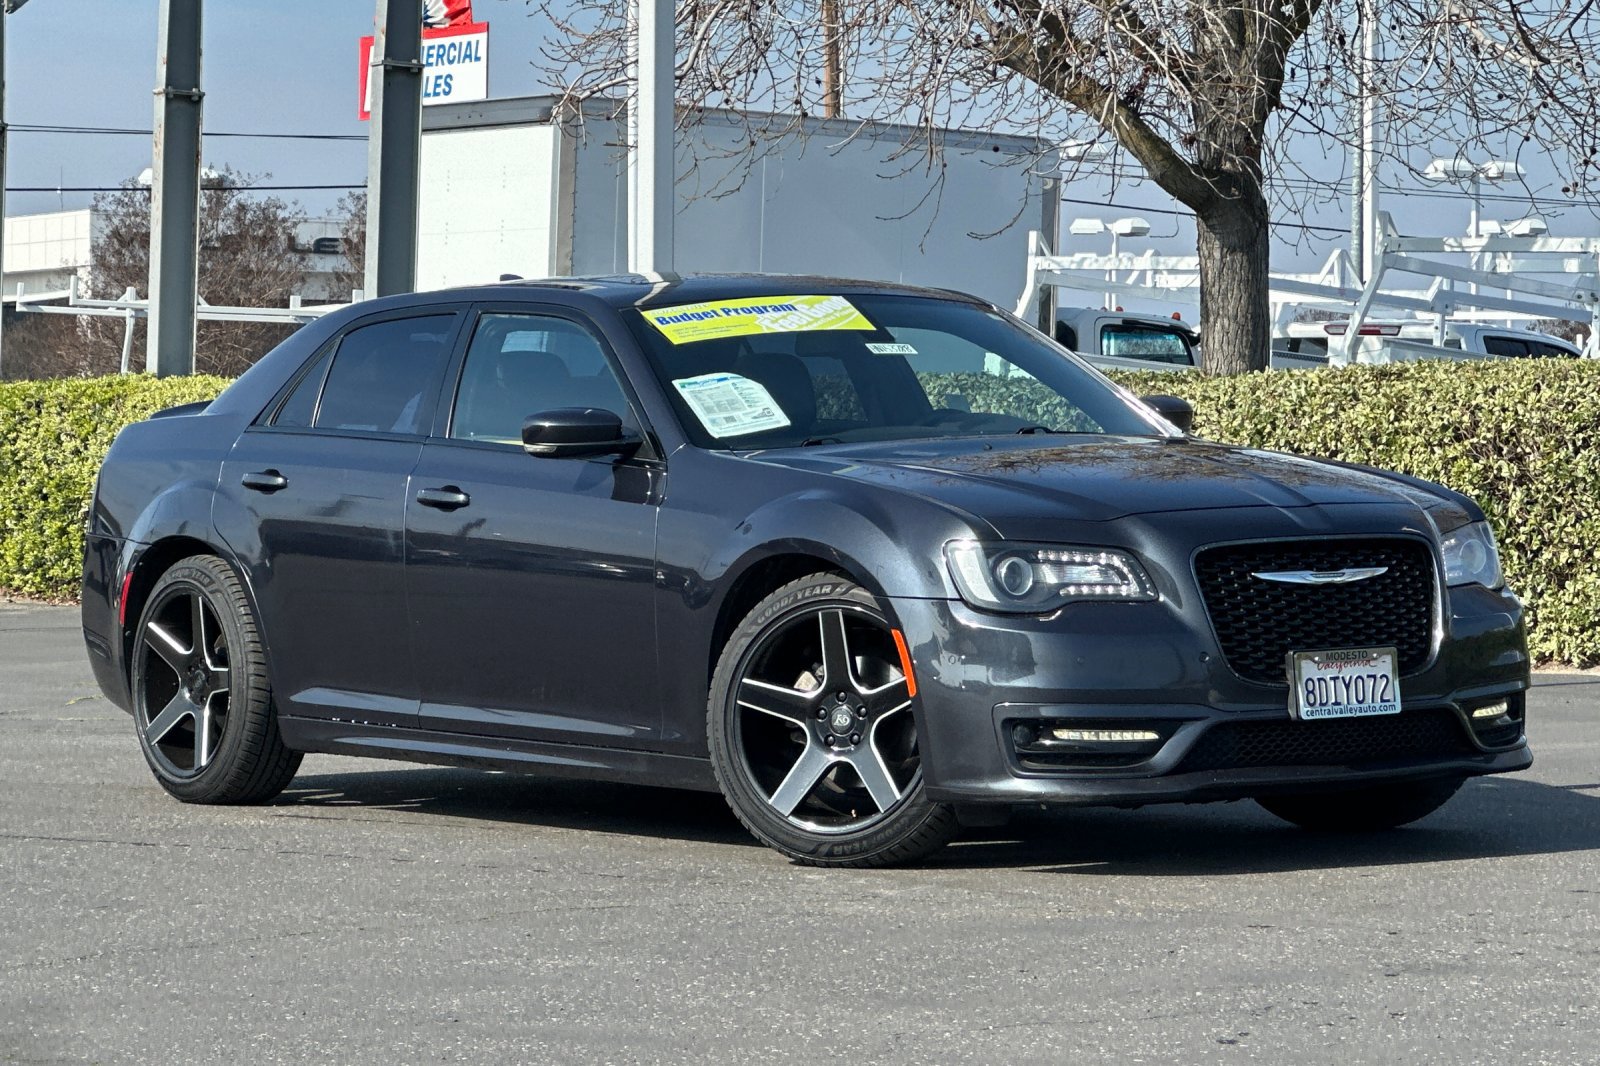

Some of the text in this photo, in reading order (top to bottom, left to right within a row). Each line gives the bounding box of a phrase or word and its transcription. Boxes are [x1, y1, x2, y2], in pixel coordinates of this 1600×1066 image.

[421, 40, 482, 67] ERCIAL
[655, 309, 721, 325] Budget
[721, 303, 798, 316] Program
[1326, 651, 1368, 661] MODESTO
[1305, 673, 1390, 707] 8DIY072
[1305, 703, 1397, 717] centralvalleyauto.com
